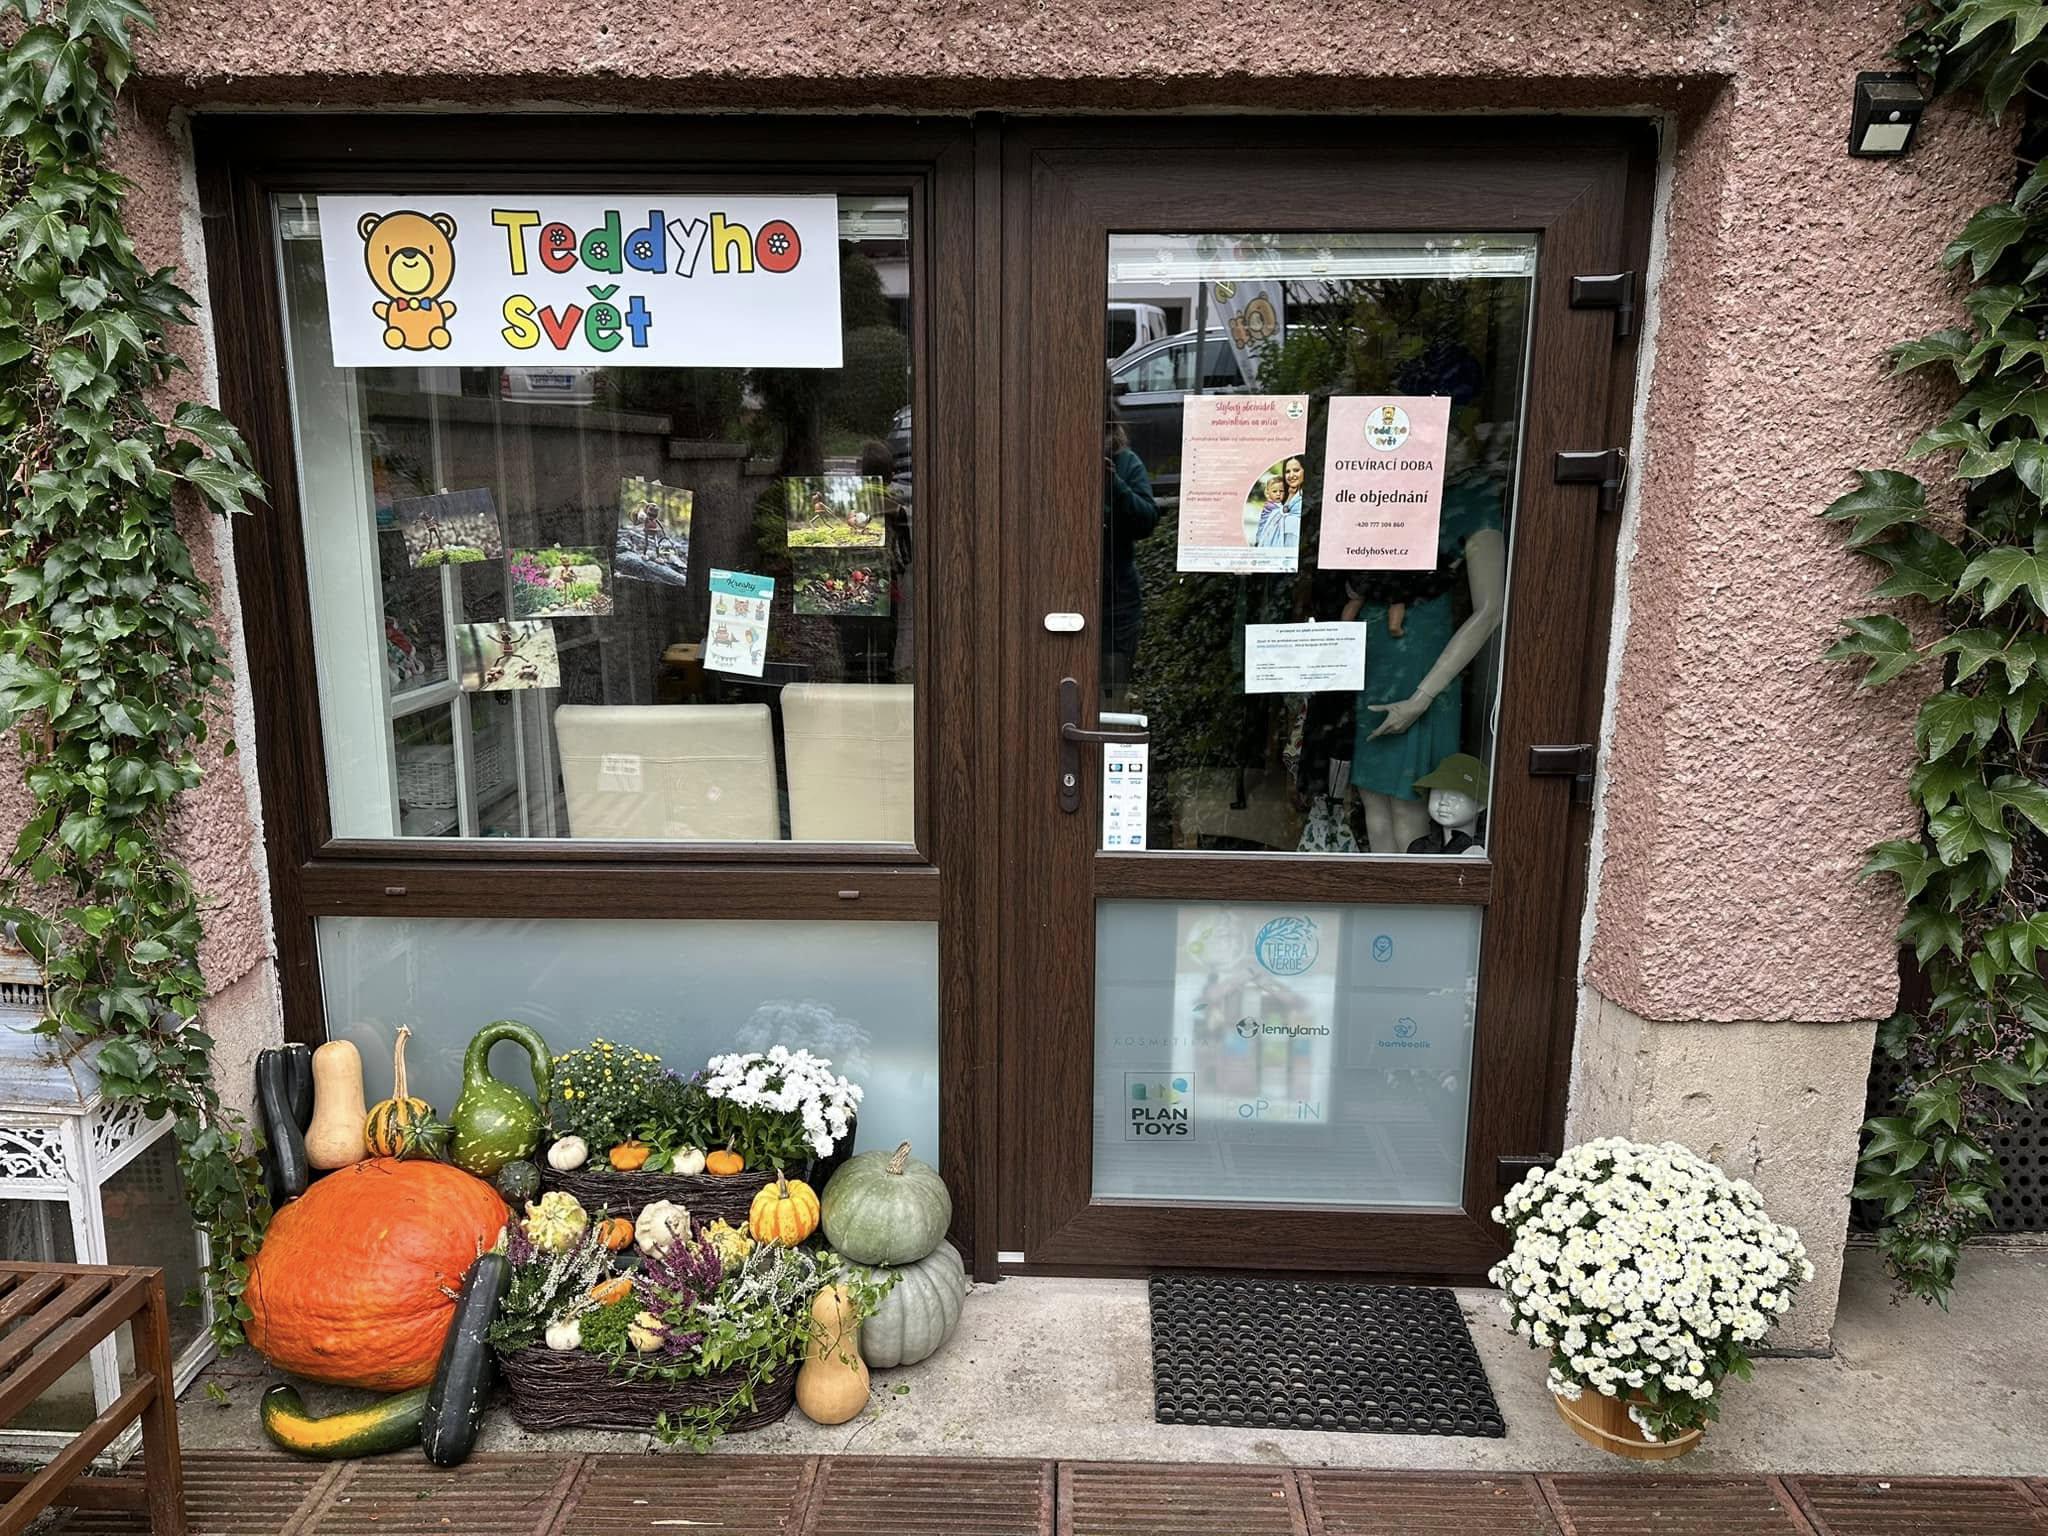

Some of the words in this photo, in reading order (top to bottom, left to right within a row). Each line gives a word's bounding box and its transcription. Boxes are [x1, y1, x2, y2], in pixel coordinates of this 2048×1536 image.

[491, 209, 802, 278] Teddyho
[501, 284, 653, 353] Svět
[1335, 458, 1397, 471] OTEVÍRACÍ
[1400, 460, 1433, 471] DOBA
[1335, 490, 1357, 503] dle
[1360, 489, 1428, 507] objednání
[1346, 546, 1409, 557] TeddyhoSvet.cz
[1266, 943, 1308, 957] TIERRA
[1269, 958, 1302, 970] VERDE
[1262, 1024, 1330, 1038] lennylamb
[1131, 1108, 1188, 1120] PLAN
[1132, 1122, 1188, 1135] TOYS
